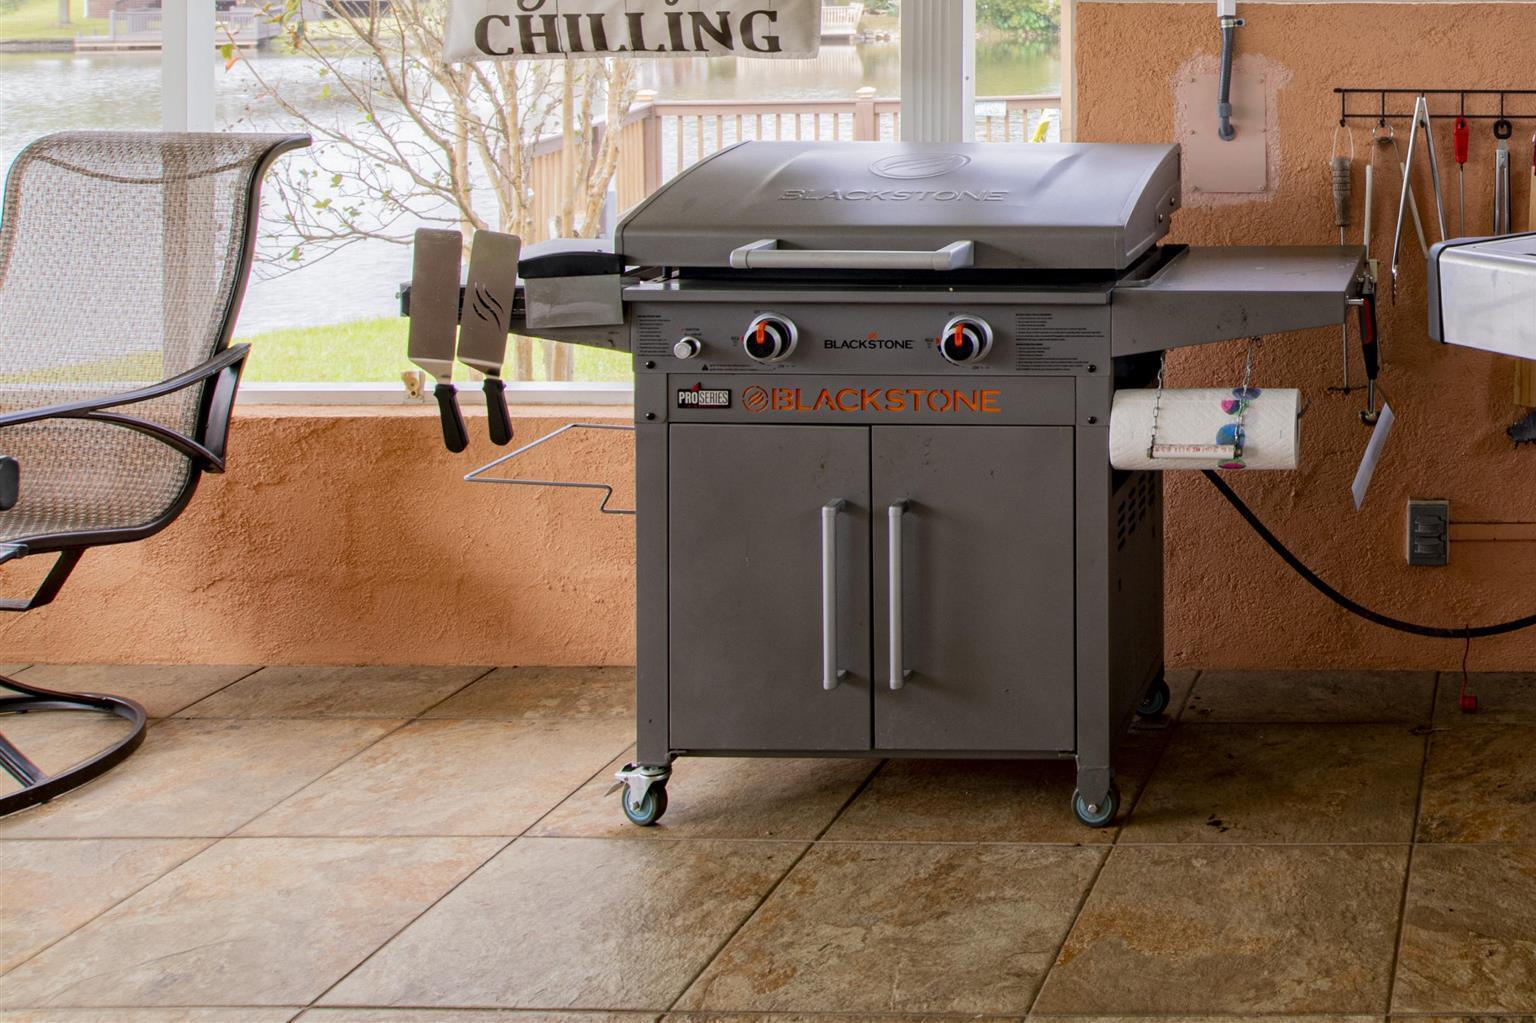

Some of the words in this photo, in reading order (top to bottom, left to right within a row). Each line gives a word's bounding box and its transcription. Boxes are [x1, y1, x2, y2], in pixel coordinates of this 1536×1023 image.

[475, 10, 782, 56] CHILLING
[777, 189, 1009, 201] BLACKSTONE
[824, 339, 914, 349] BLACKSTONE
[772, 387, 1001, 412] BLACKSTONE
